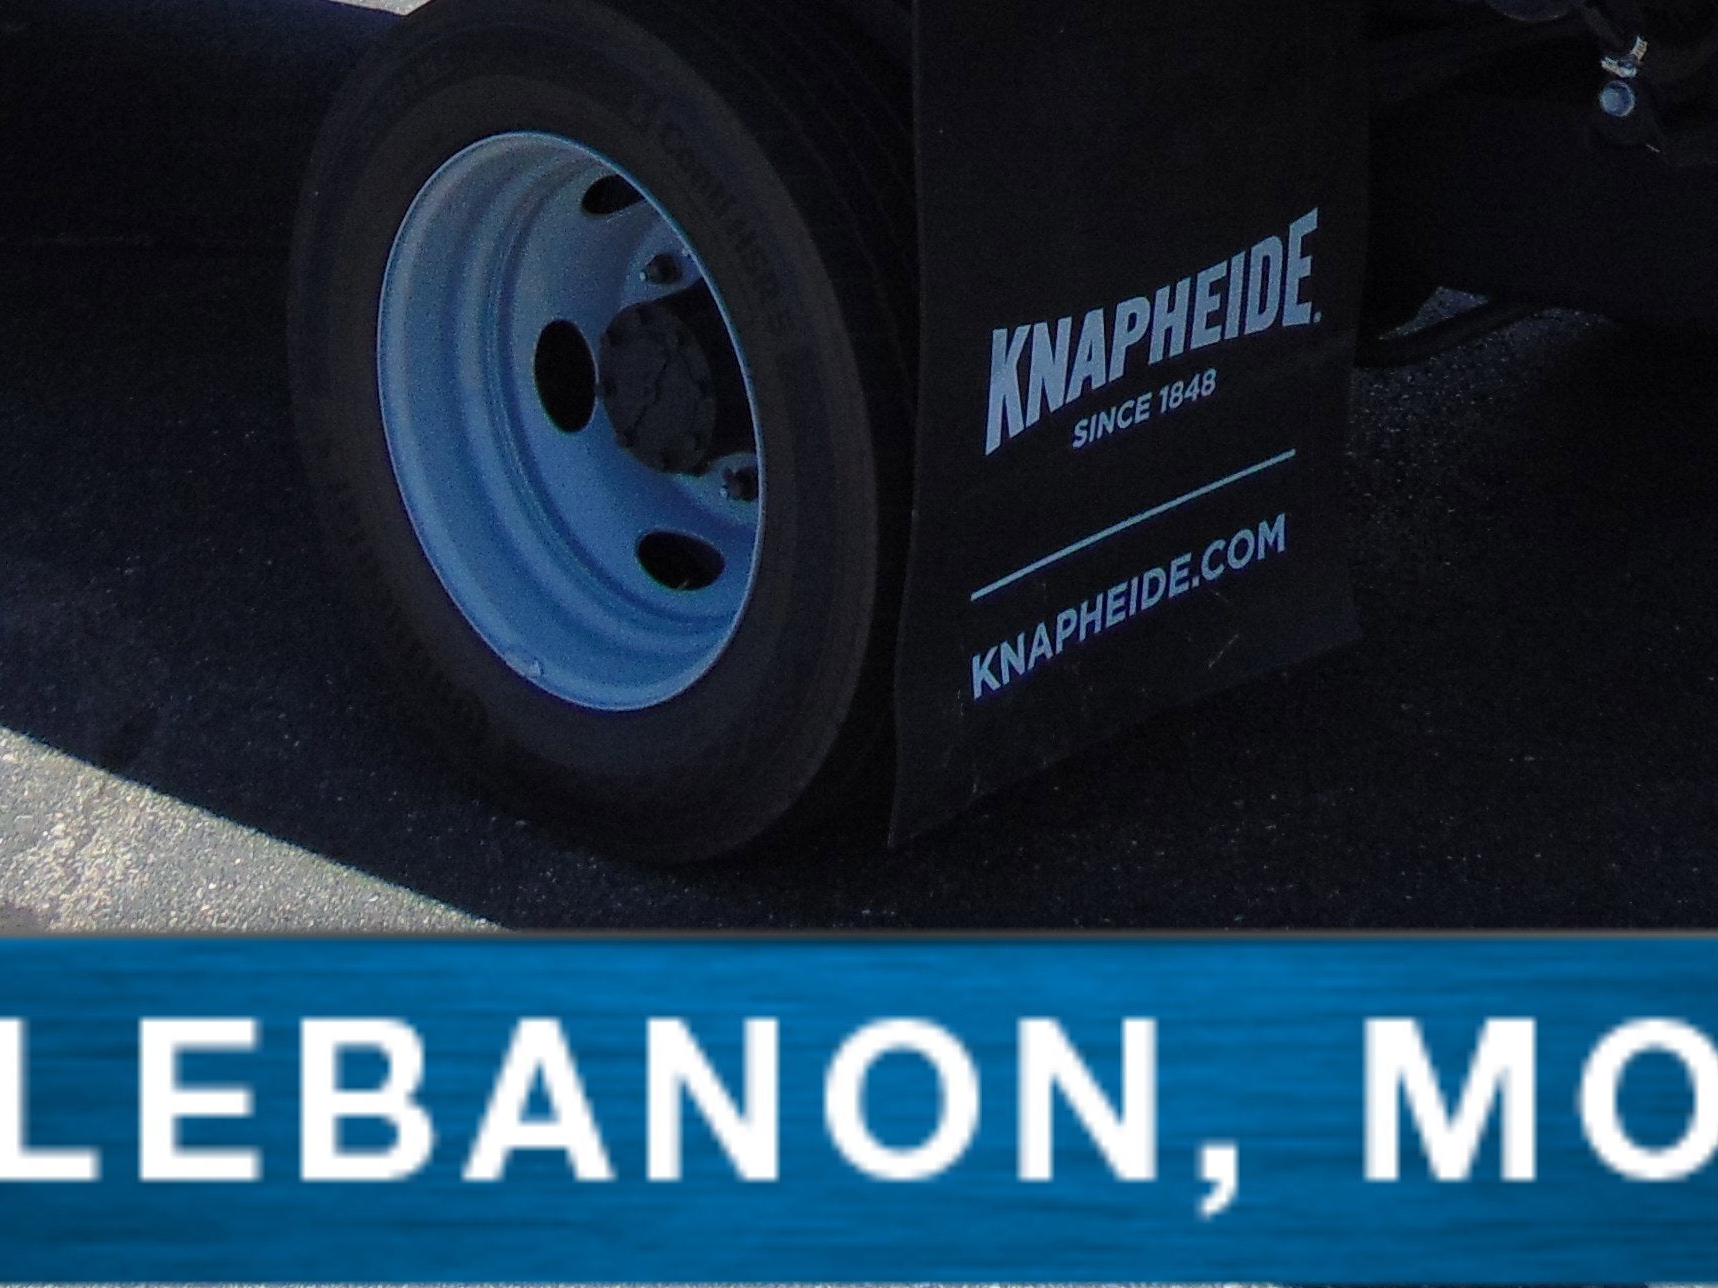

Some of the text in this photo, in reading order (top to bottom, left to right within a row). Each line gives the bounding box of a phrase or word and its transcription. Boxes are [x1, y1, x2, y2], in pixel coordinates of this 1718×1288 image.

[985, 207, 1318, 456] KNAPHEIDE
[1072, 368, 1217, 449] SINCE 1848
[971, 512, 1286, 701] KNAPHEIDE.COM
